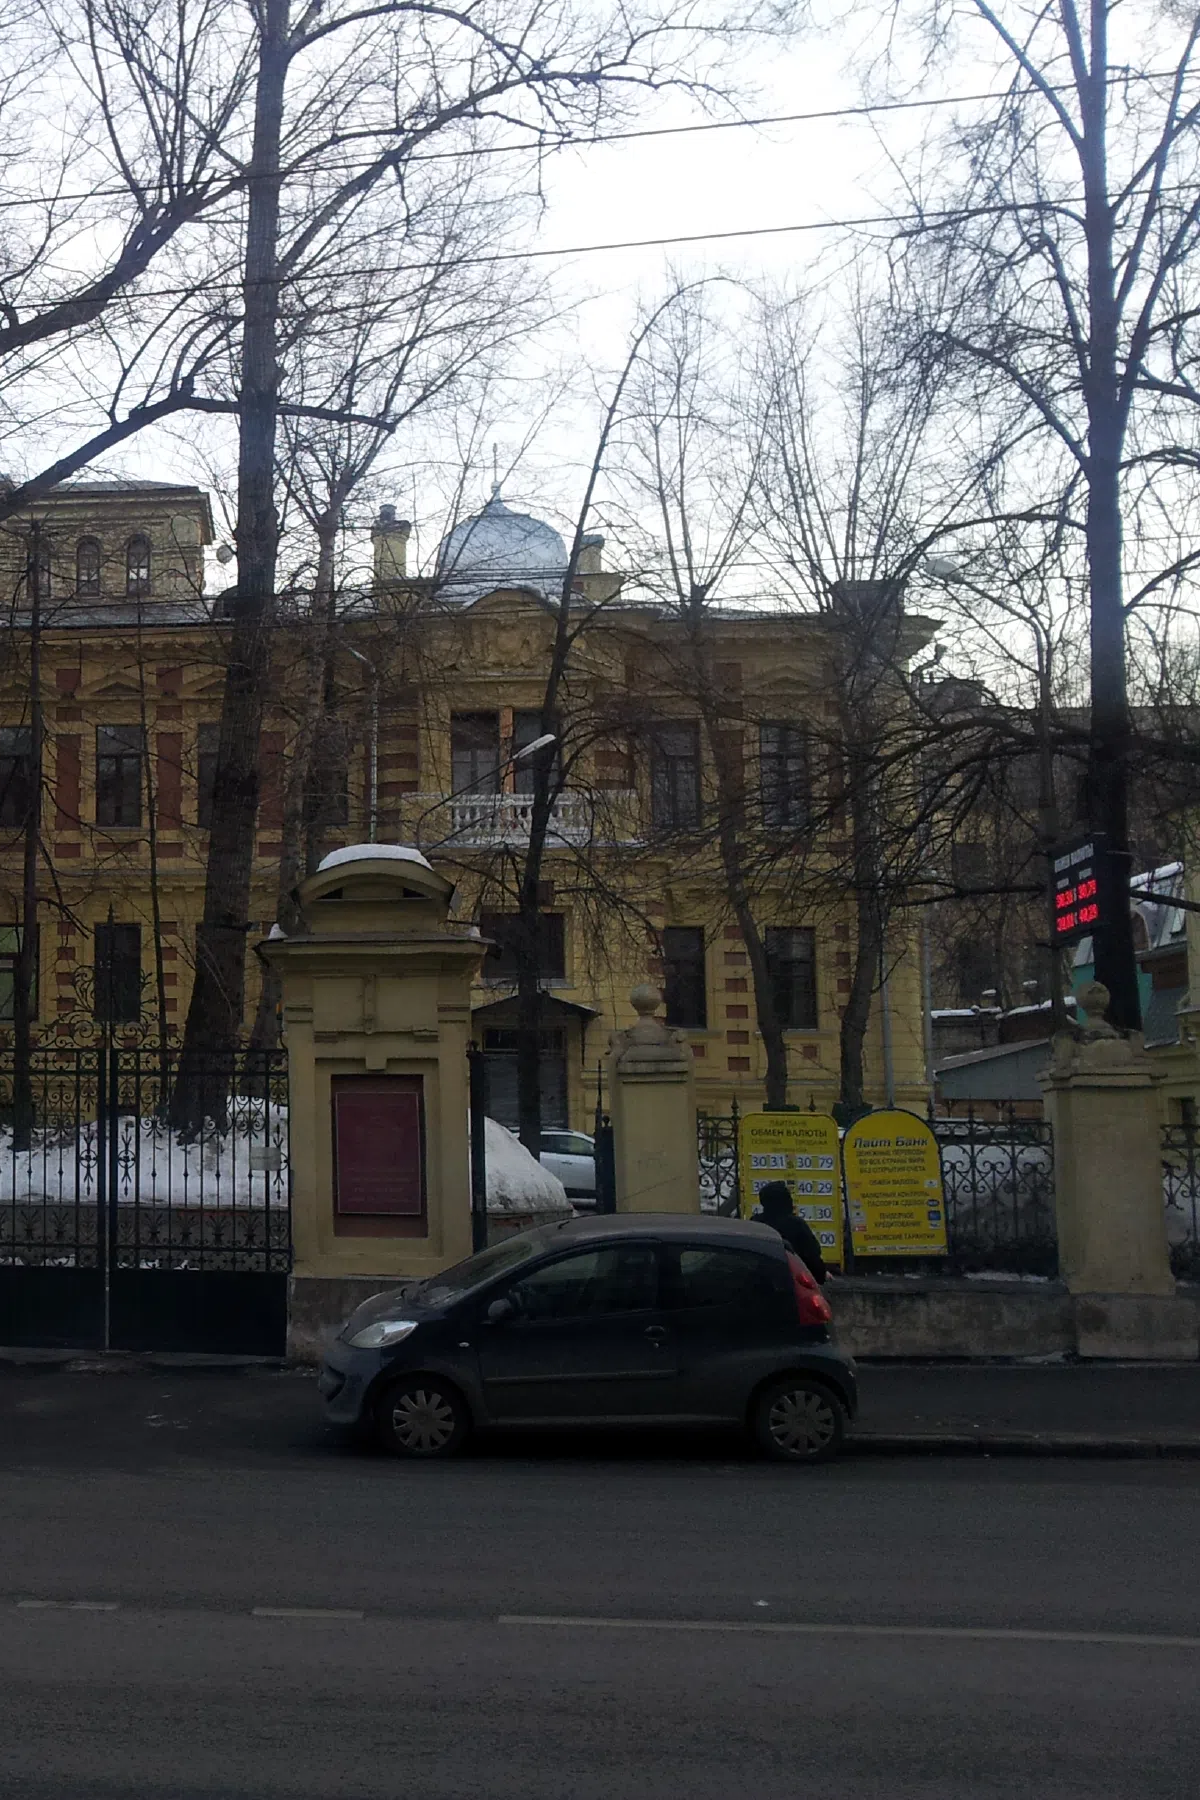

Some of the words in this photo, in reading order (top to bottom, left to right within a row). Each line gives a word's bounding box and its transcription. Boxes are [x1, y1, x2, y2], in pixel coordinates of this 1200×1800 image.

[751, 1128, 784, 1137] ОБМЕН
[786, 1128, 827, 1137] ВАЛЮТЫ
[853, 1137, 891, 1148] Лайт
[896, 1136, 928, 1147] Банк
